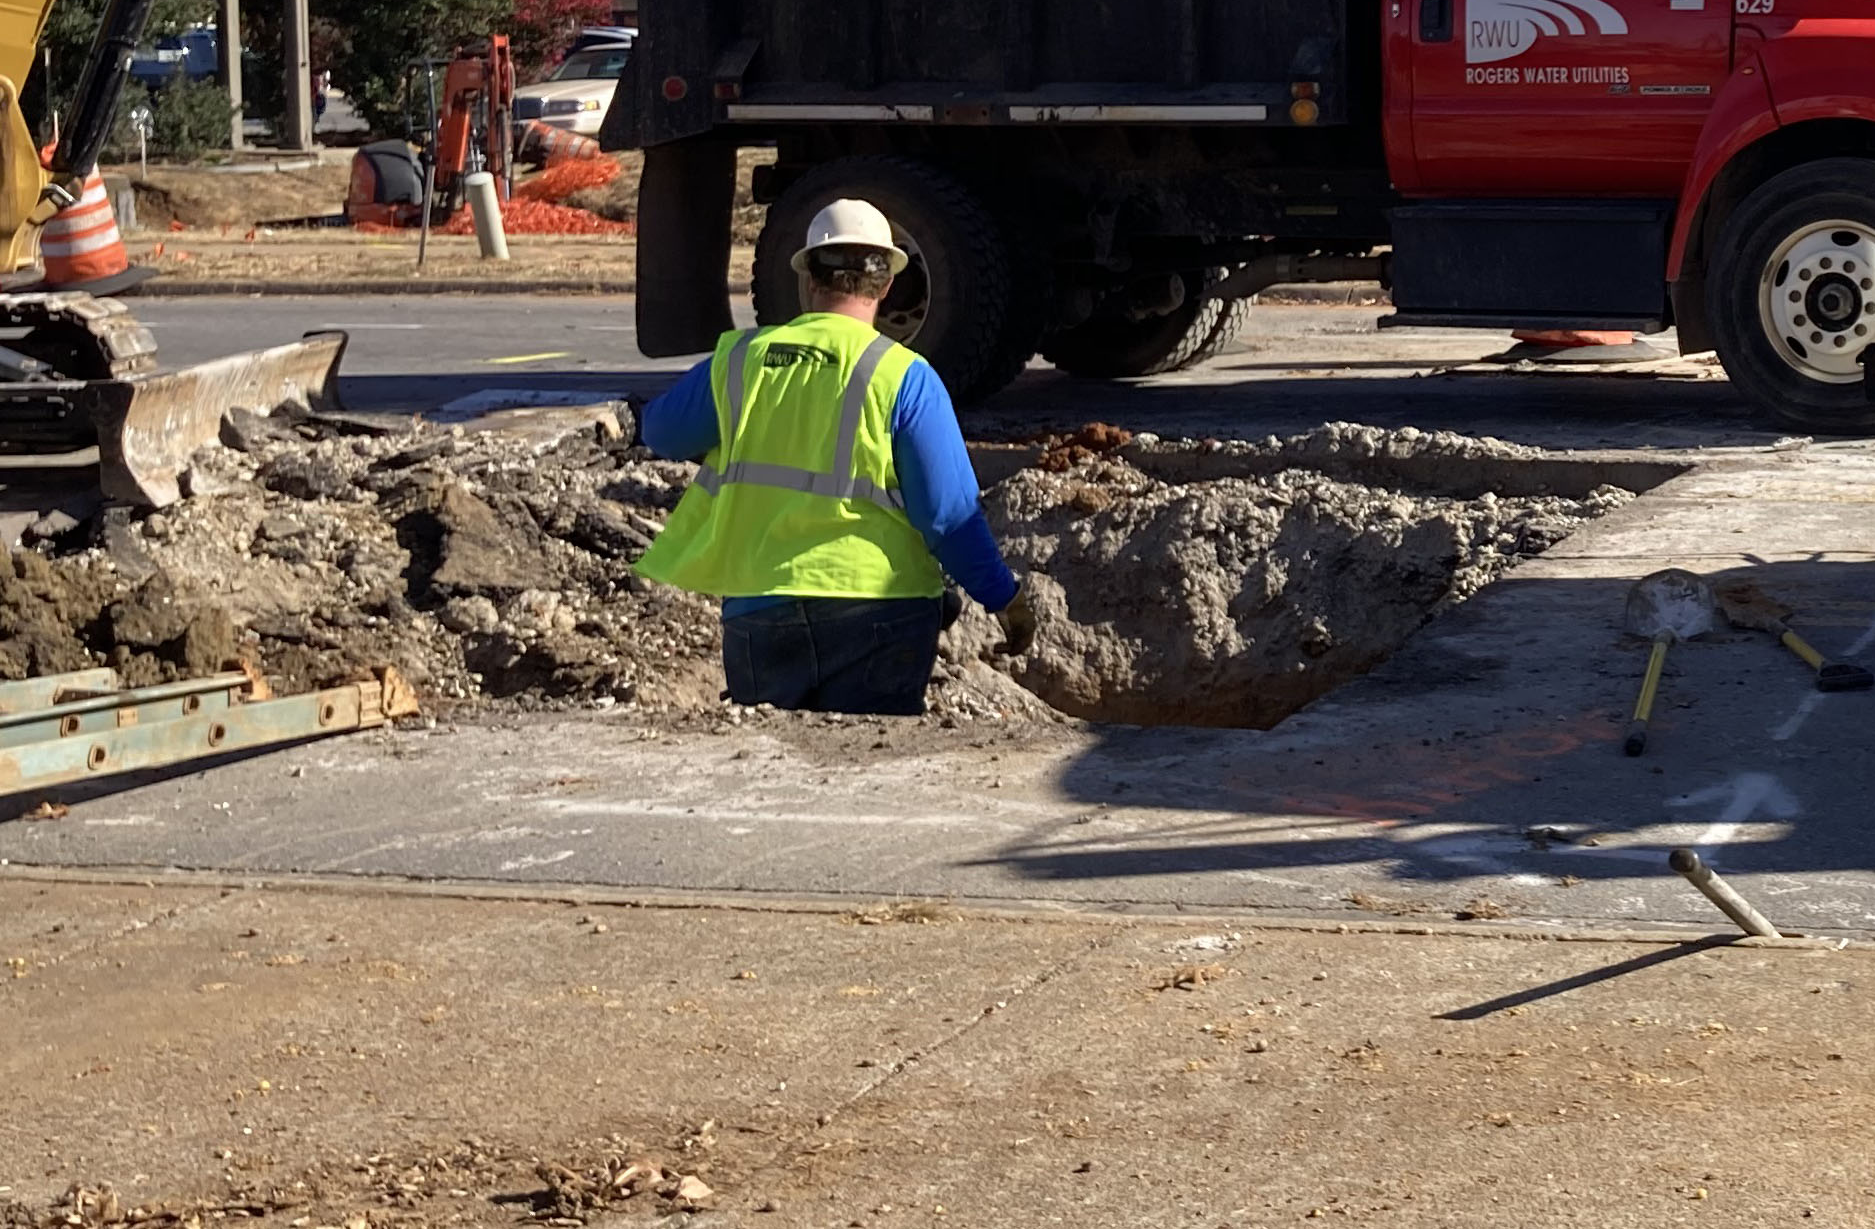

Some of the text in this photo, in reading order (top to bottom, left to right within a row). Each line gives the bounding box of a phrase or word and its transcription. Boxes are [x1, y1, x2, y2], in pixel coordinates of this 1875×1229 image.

[1471, 20, 1520, 48] RWU
[1466, 67, 1629, 84] ROGERS WATER UTILITIES
